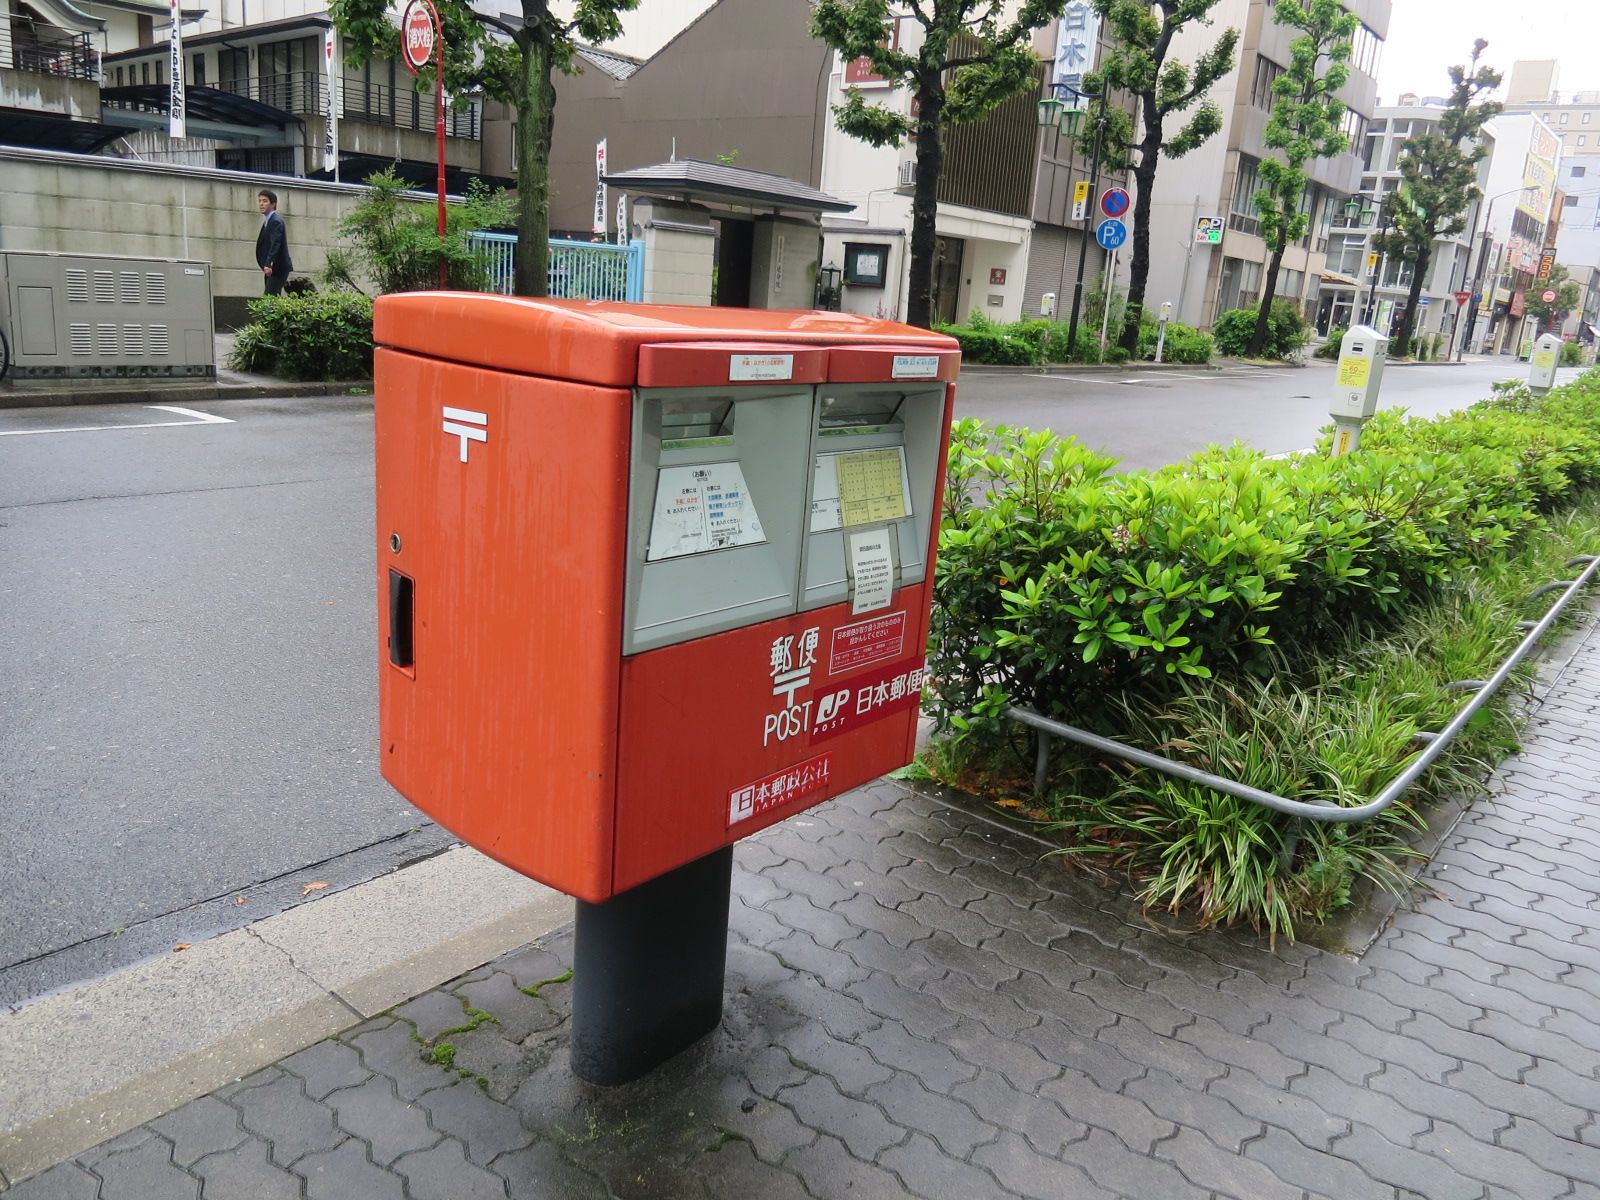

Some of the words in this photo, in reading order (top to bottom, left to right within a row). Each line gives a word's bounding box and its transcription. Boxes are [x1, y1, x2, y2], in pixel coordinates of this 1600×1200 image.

[410, 27, 431, 48] 消火栓
[1102, 226, 1115, 245] P
[1110, 237, 1119, 245] 60
[769, 626, 820, 677] 郵便
[856, 668, 923, 715] 日本郵便
[763, 700, 813, 747] POST
[813, 717, 846, 735] POST
[738, 758, 830, 813] 日本郵政公社
